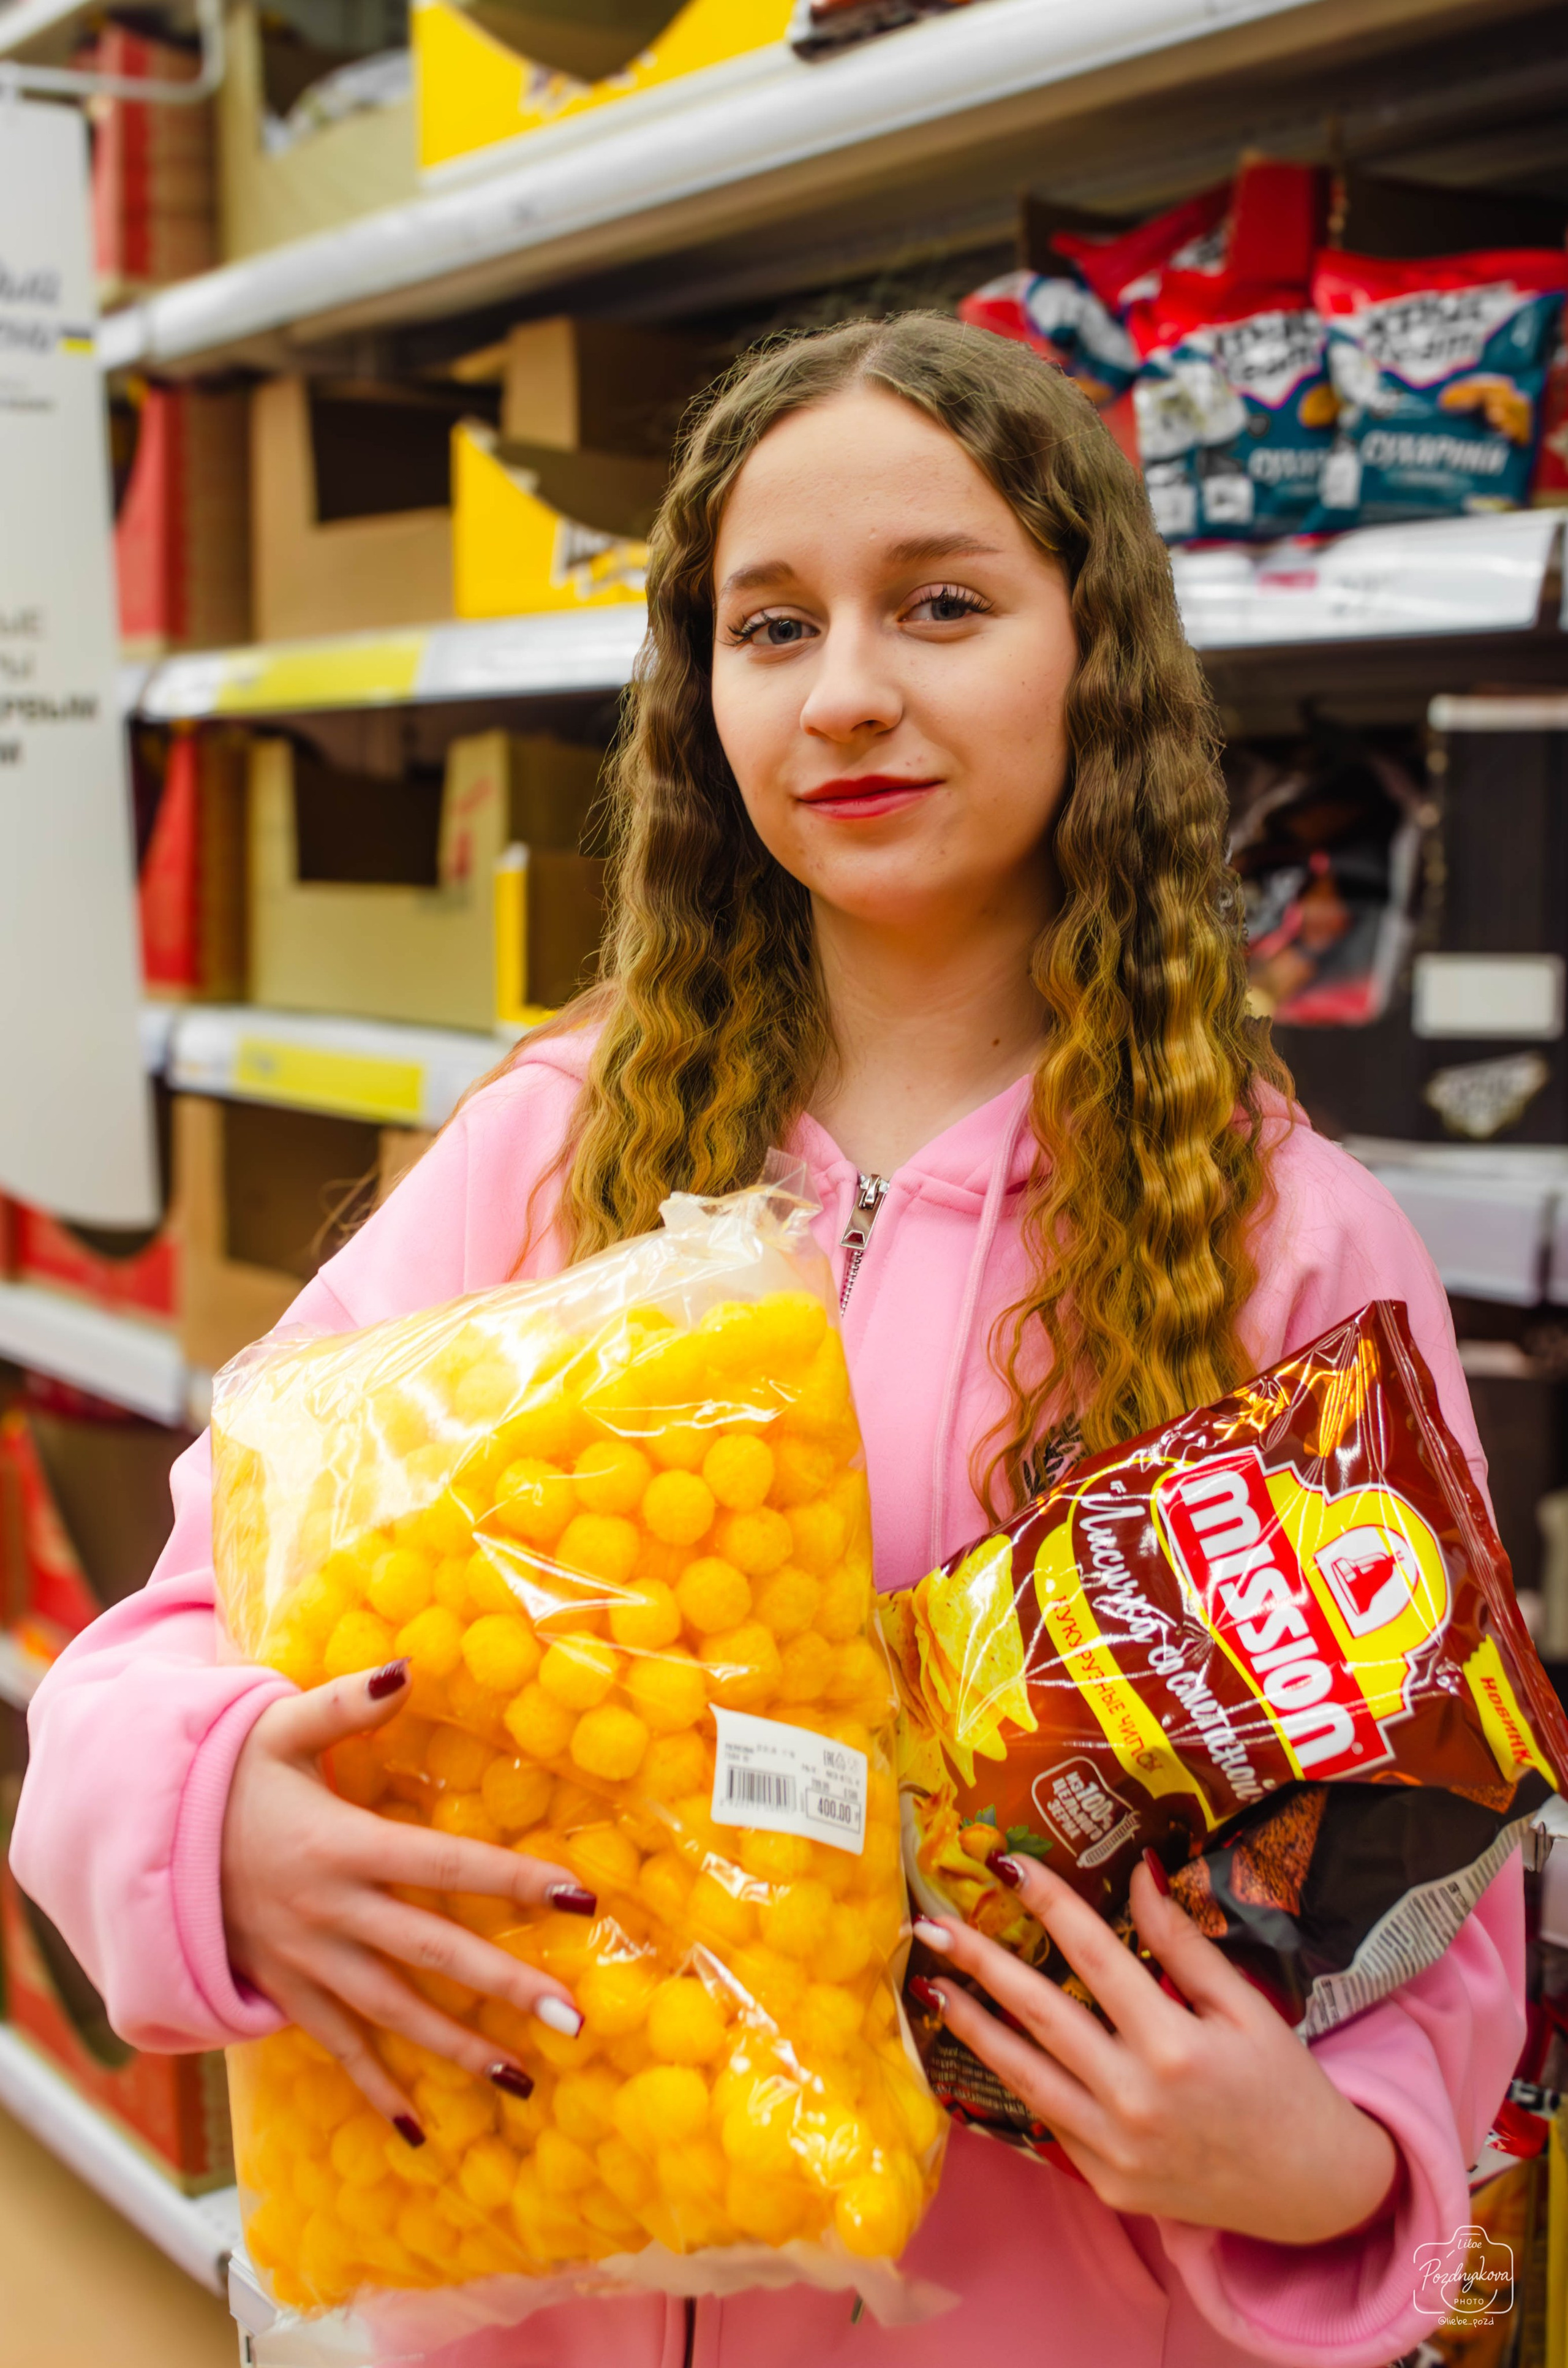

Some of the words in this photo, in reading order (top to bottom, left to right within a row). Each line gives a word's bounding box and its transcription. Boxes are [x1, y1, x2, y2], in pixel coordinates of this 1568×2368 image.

[1054, 1594, 1126, 1715] КУКУРУЗНЫЕ
[1118, 1714, 1163, 1773] ЧИПСЫ
[1166, 1670, 1276, 1802] сметаной
[1480, 1676, 1534, 1765] НОВИНК
[817, 1796, 851, 1825] 400.00
[1047, 1798, 1082, 1840] ЗЕРНА
[1052, 1777, 1103, 1842] ЦЕЛЬНОГО
[1065, 1770, 1085, 1793] ИЗ
[1075, 1781, 1114, 1831] 100%
